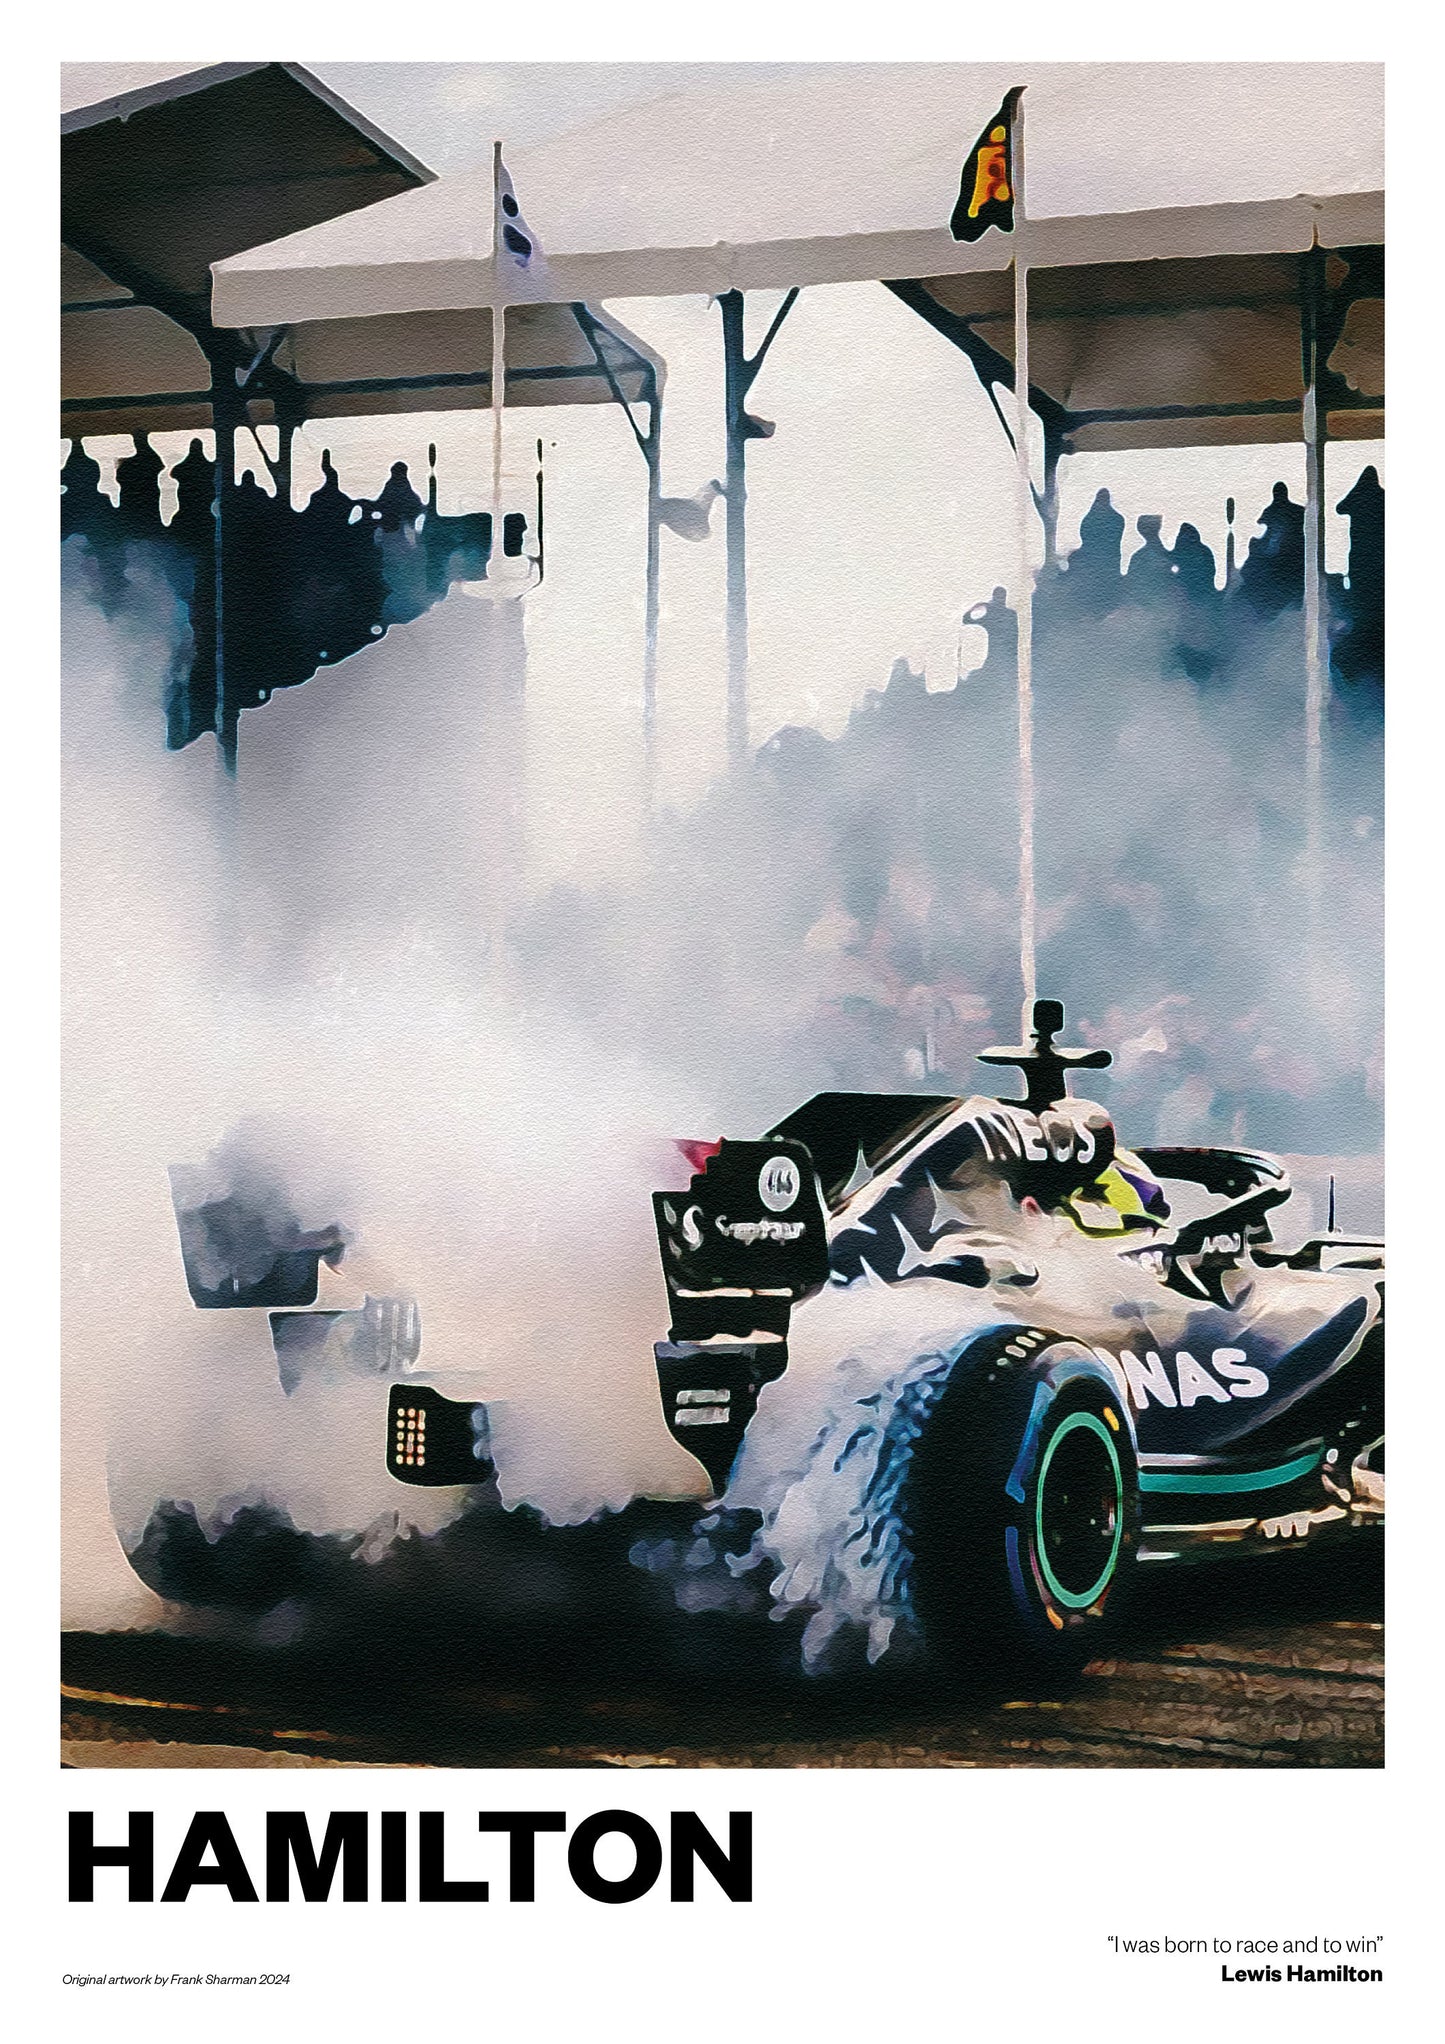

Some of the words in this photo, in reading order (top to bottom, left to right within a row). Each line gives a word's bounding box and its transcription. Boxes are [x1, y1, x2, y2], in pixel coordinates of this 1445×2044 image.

[969, 1106, 1096, 1163] INEOS
[68, 1808, 753, 1905] HAMILTON
[1123, 1940, 1160, 1954] was
[1165, 1935, 1208, 1954] born
[1213, 1937, 1232, 1954] to
[1236, 1940, 1279, 1954] race
[1283, 1935, 1318, 1954] and
[1323, 1937, 1342, 1954] to
[62, 1973, 107, 1988] Original
[108, 1973, 153, 1986] artwork
[154, 1973, 170, 1988] by
[170, 1973, 204, 1986] Frank
[205, 1973, 258, 1986] Sharman
[258, 1973, 291, 1986] 2024
[1221, 1964, 1283, 1983] Lewis
[1287, 1964, 1383, 1983] Hamilton
